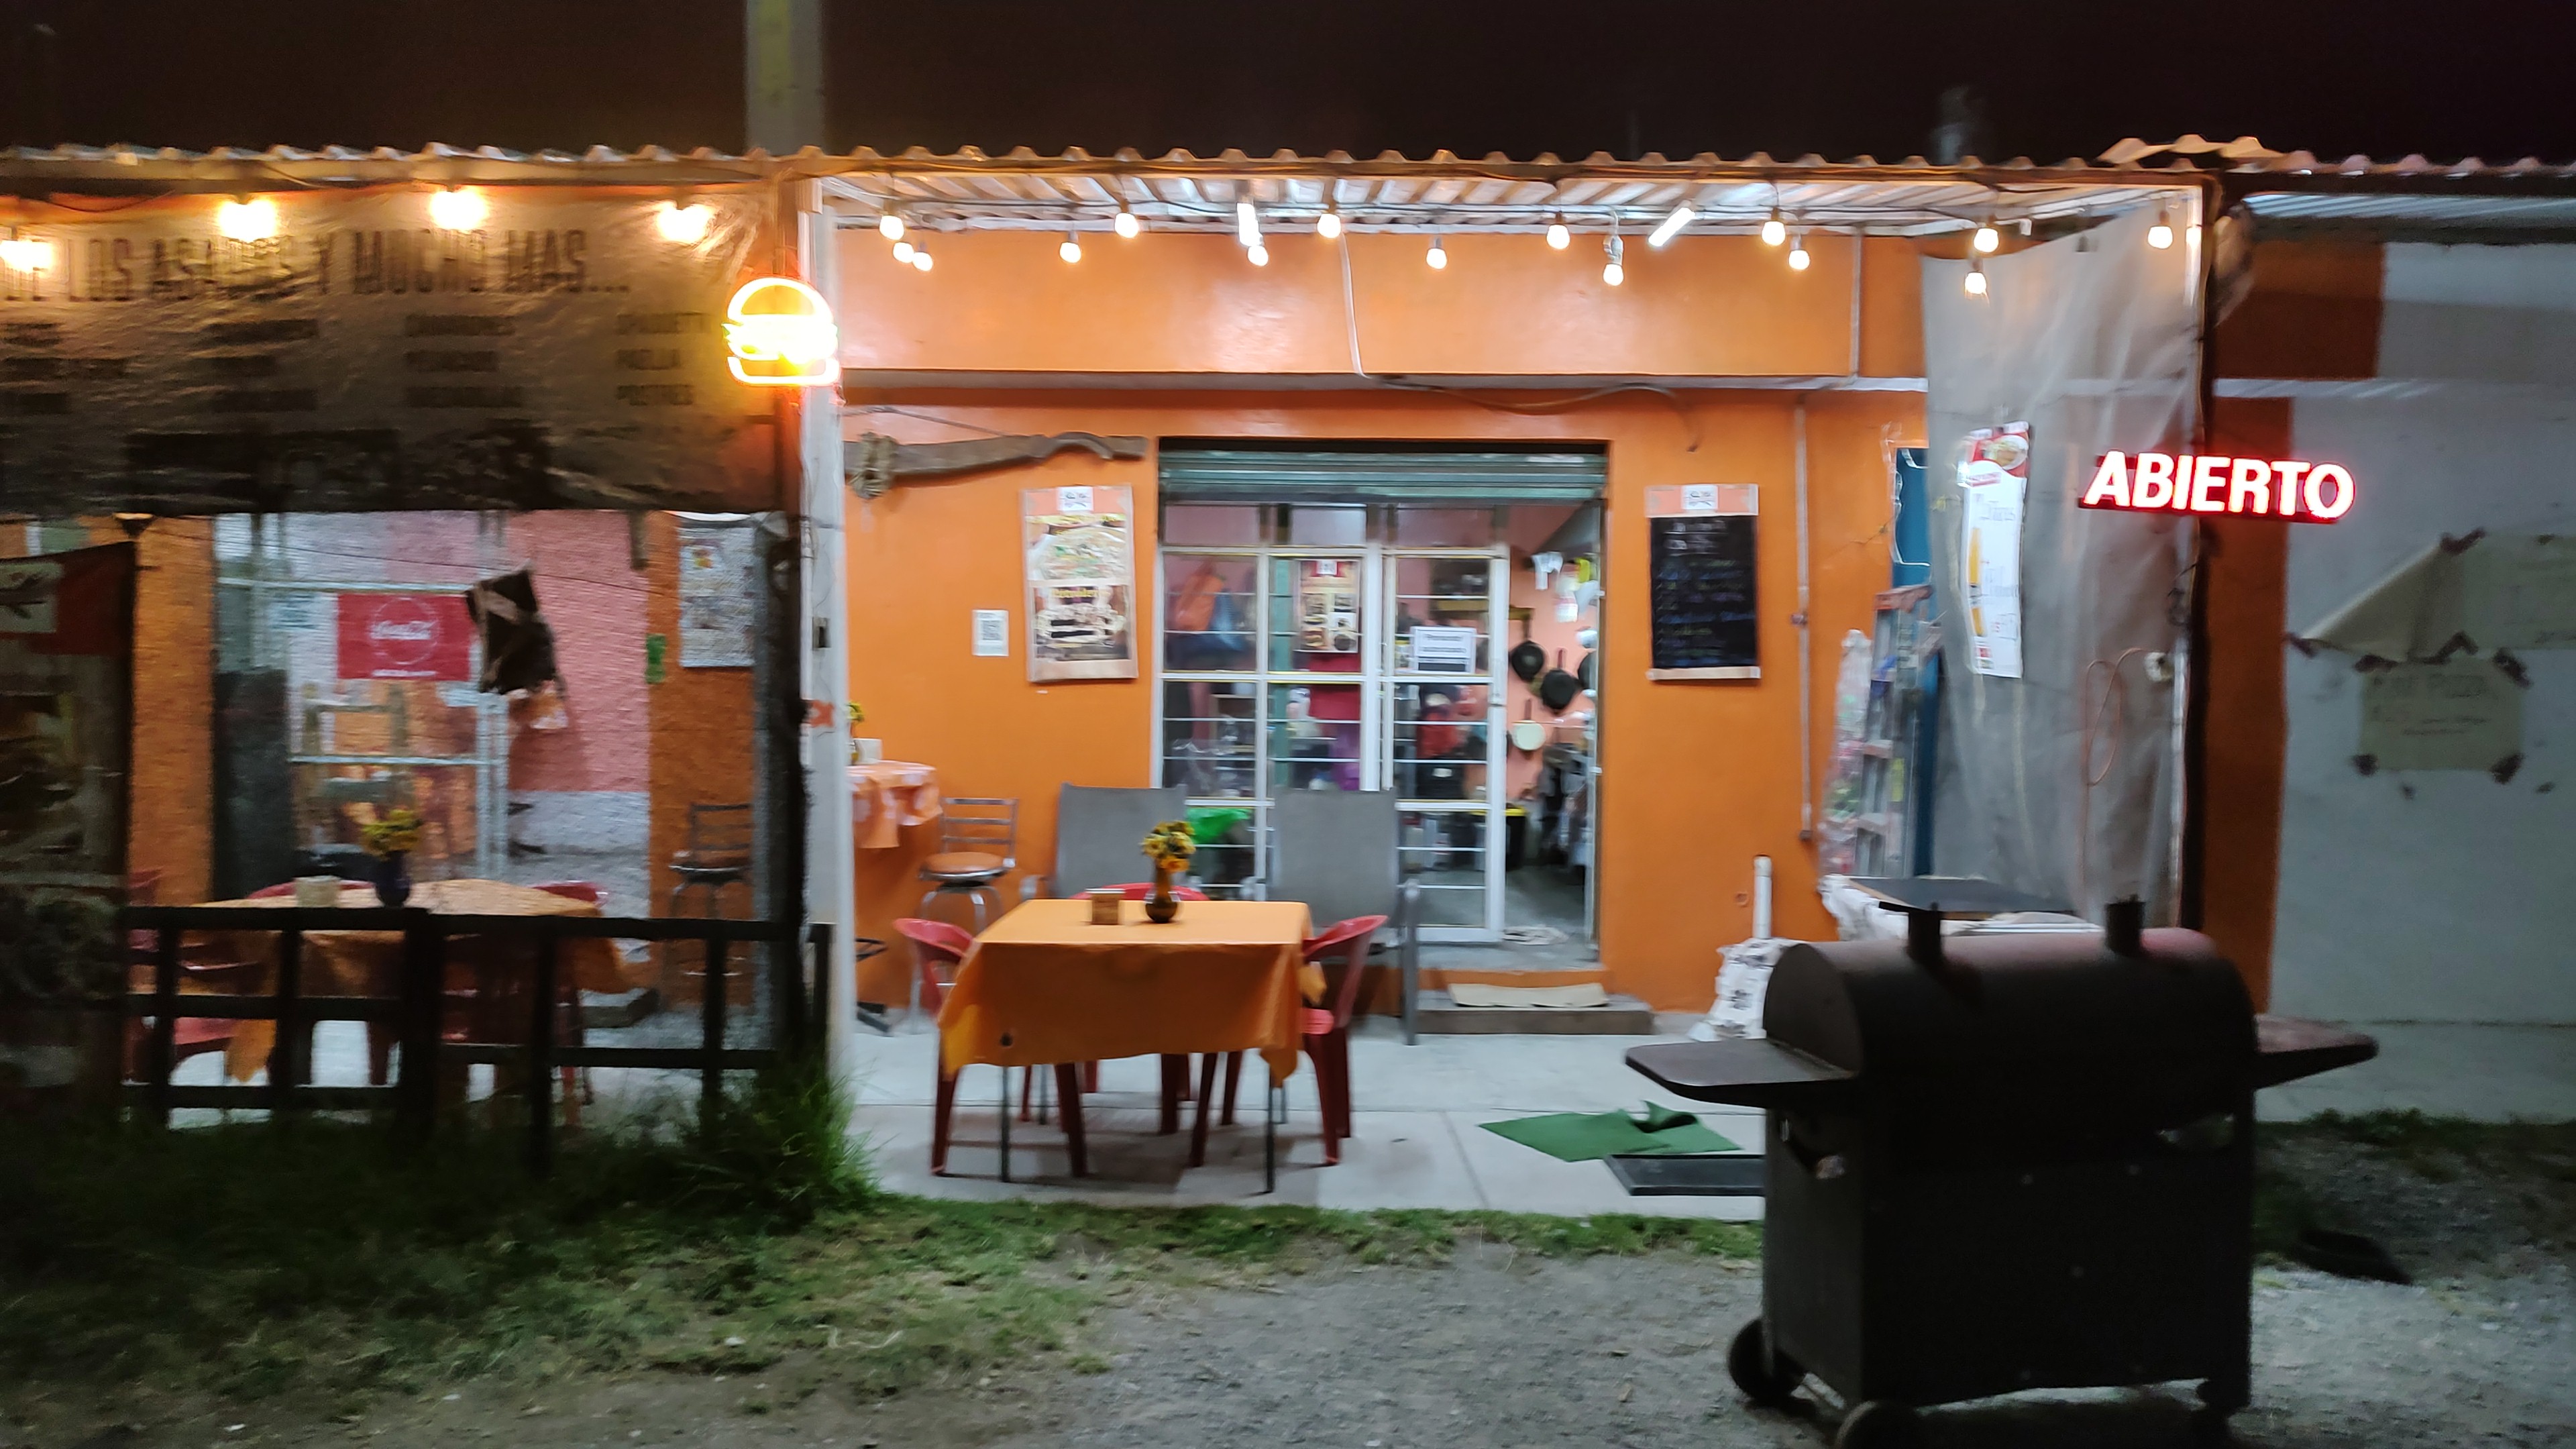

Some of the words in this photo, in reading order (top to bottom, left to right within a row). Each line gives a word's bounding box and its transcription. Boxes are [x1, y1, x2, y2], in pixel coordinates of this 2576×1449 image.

[66, 237, 132, 302] LOS
[353, 228, 488, 295] MUCHO
[2082, 450, 2356, 521] ABIERTO
